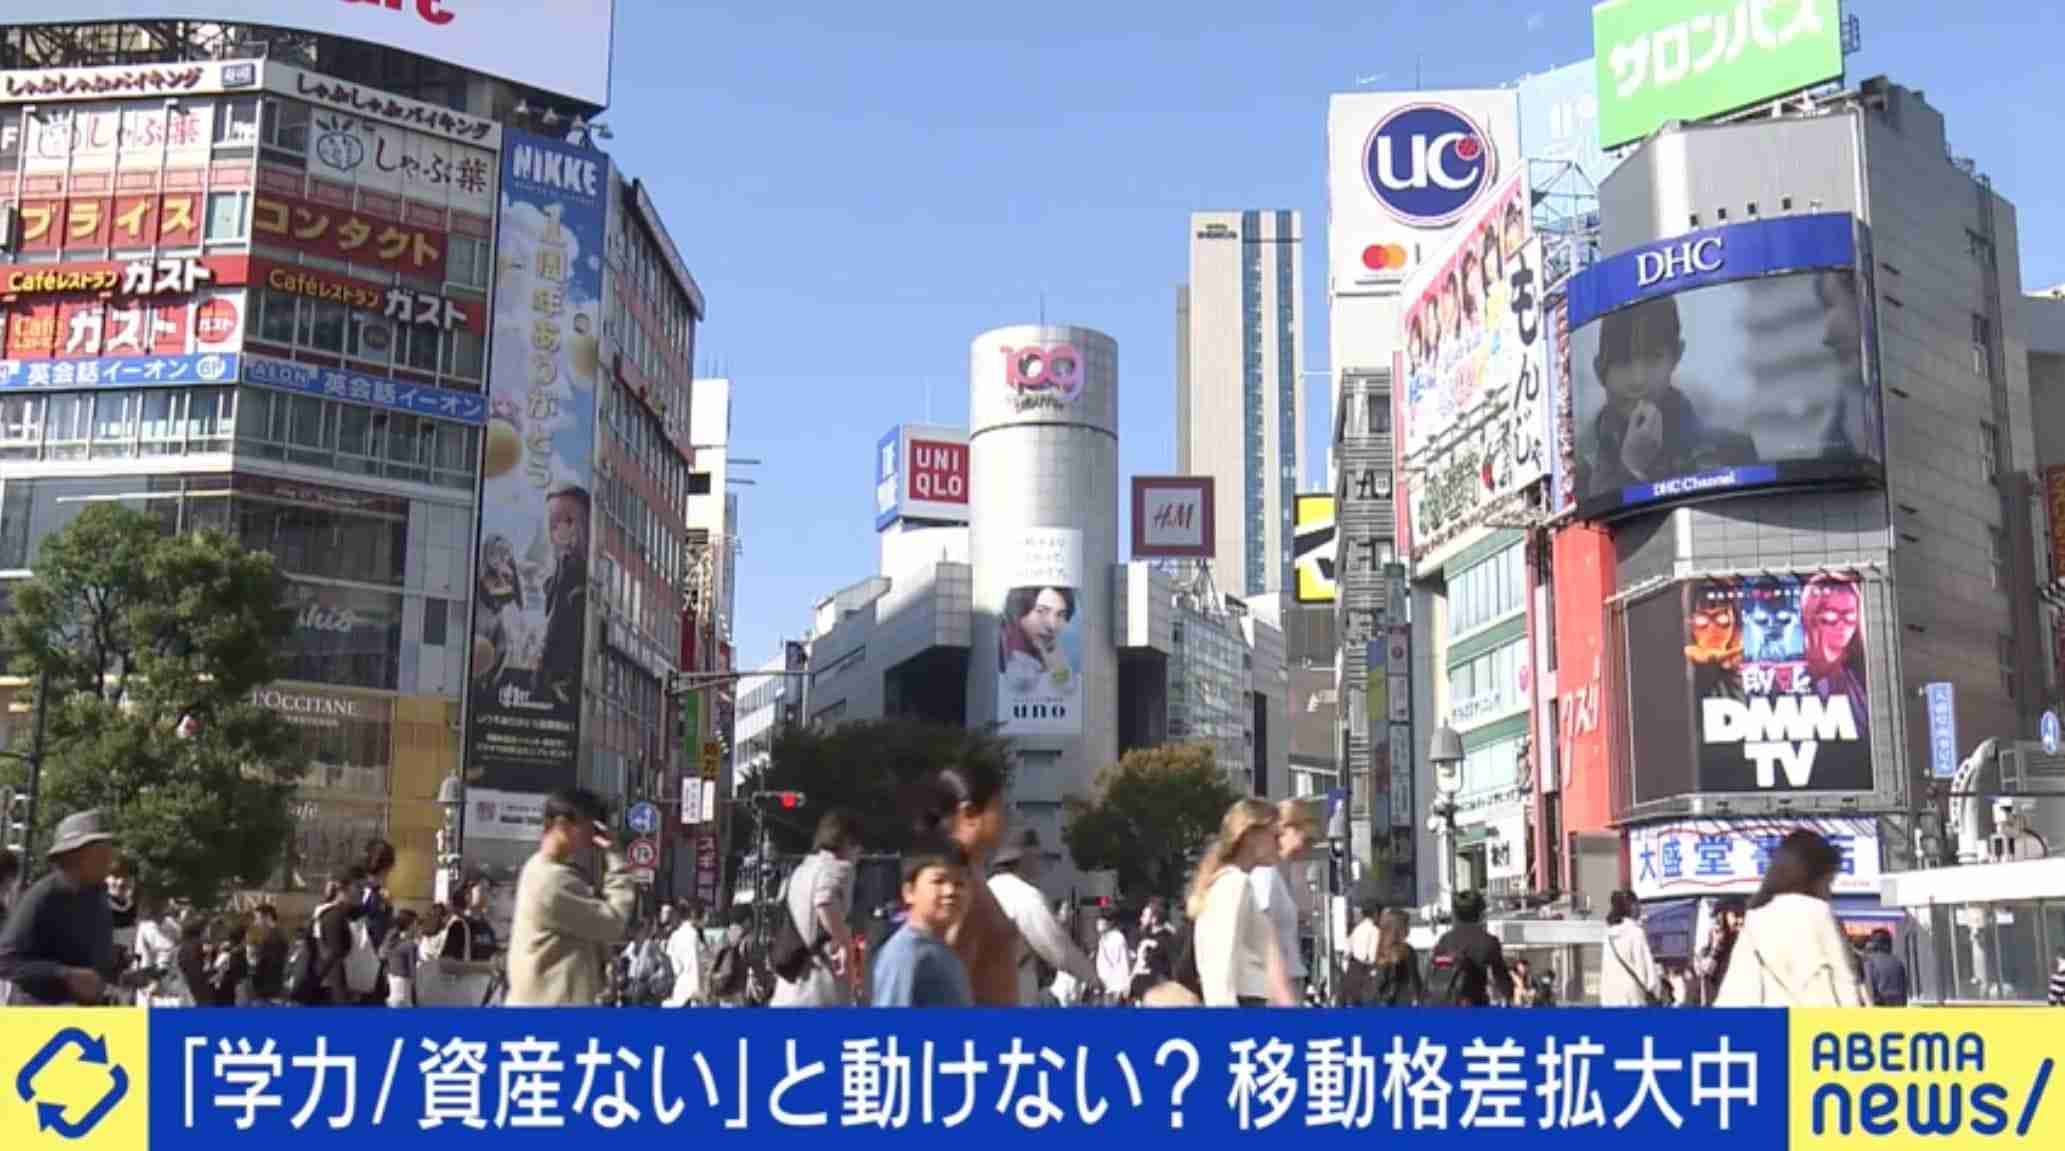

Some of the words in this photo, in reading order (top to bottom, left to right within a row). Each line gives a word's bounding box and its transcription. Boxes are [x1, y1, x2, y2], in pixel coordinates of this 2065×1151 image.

[297, 72, 491, 139] しゃぶしゃぶバイキング
[376, 136, 487, 193] しゃぶ葉
[513, 144, 598, 197] NIKKE
[255, 199, 440, 266] コンタクト
[121, 257, 213, 294] ガスト
[1636, 236, 1723, 287] DHC
[65, 306, 178, 354] ガスト
[383, 288, 468, 331] ガスト
[27, 361, 189, 385] 英会話イーオン
[323, 367, 483, 416] 英会話イーオン
[915, 447, 960, 473] UNI
[915, 472, 962, 498] QLO
[1012, 702, 1067, 720] uno
[1702, 694, 1859, 744] DMM
[1744, 739, 1818, 787] TV
